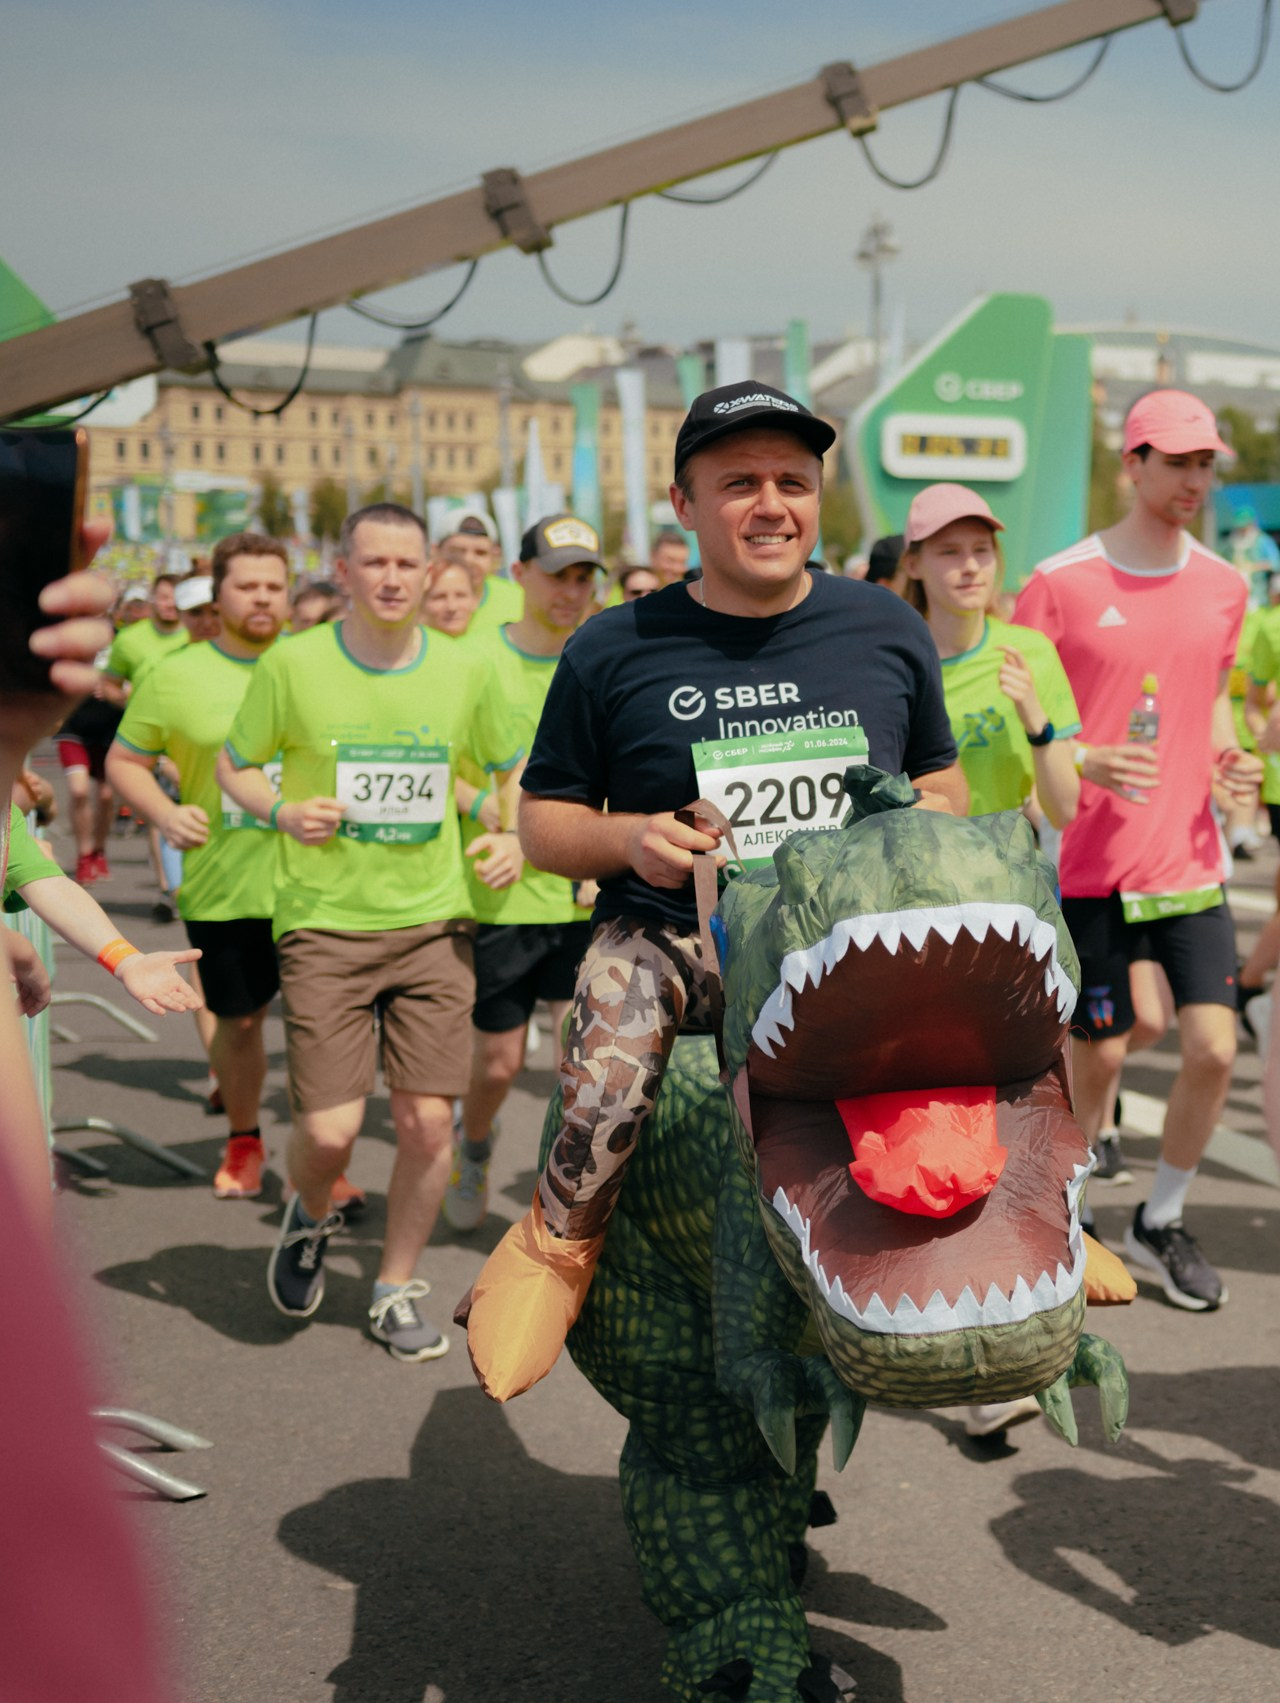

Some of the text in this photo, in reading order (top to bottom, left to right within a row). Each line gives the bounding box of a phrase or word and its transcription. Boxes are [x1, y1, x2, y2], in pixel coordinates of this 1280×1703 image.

[714, 682, 801, 710] SBER
[718, 706, 859, 740] Innovation
[804, 738, 848, 750] 01.06.2024
[353, 773, 434, 803] 3734
[724, 772, 845, 828] 2209
